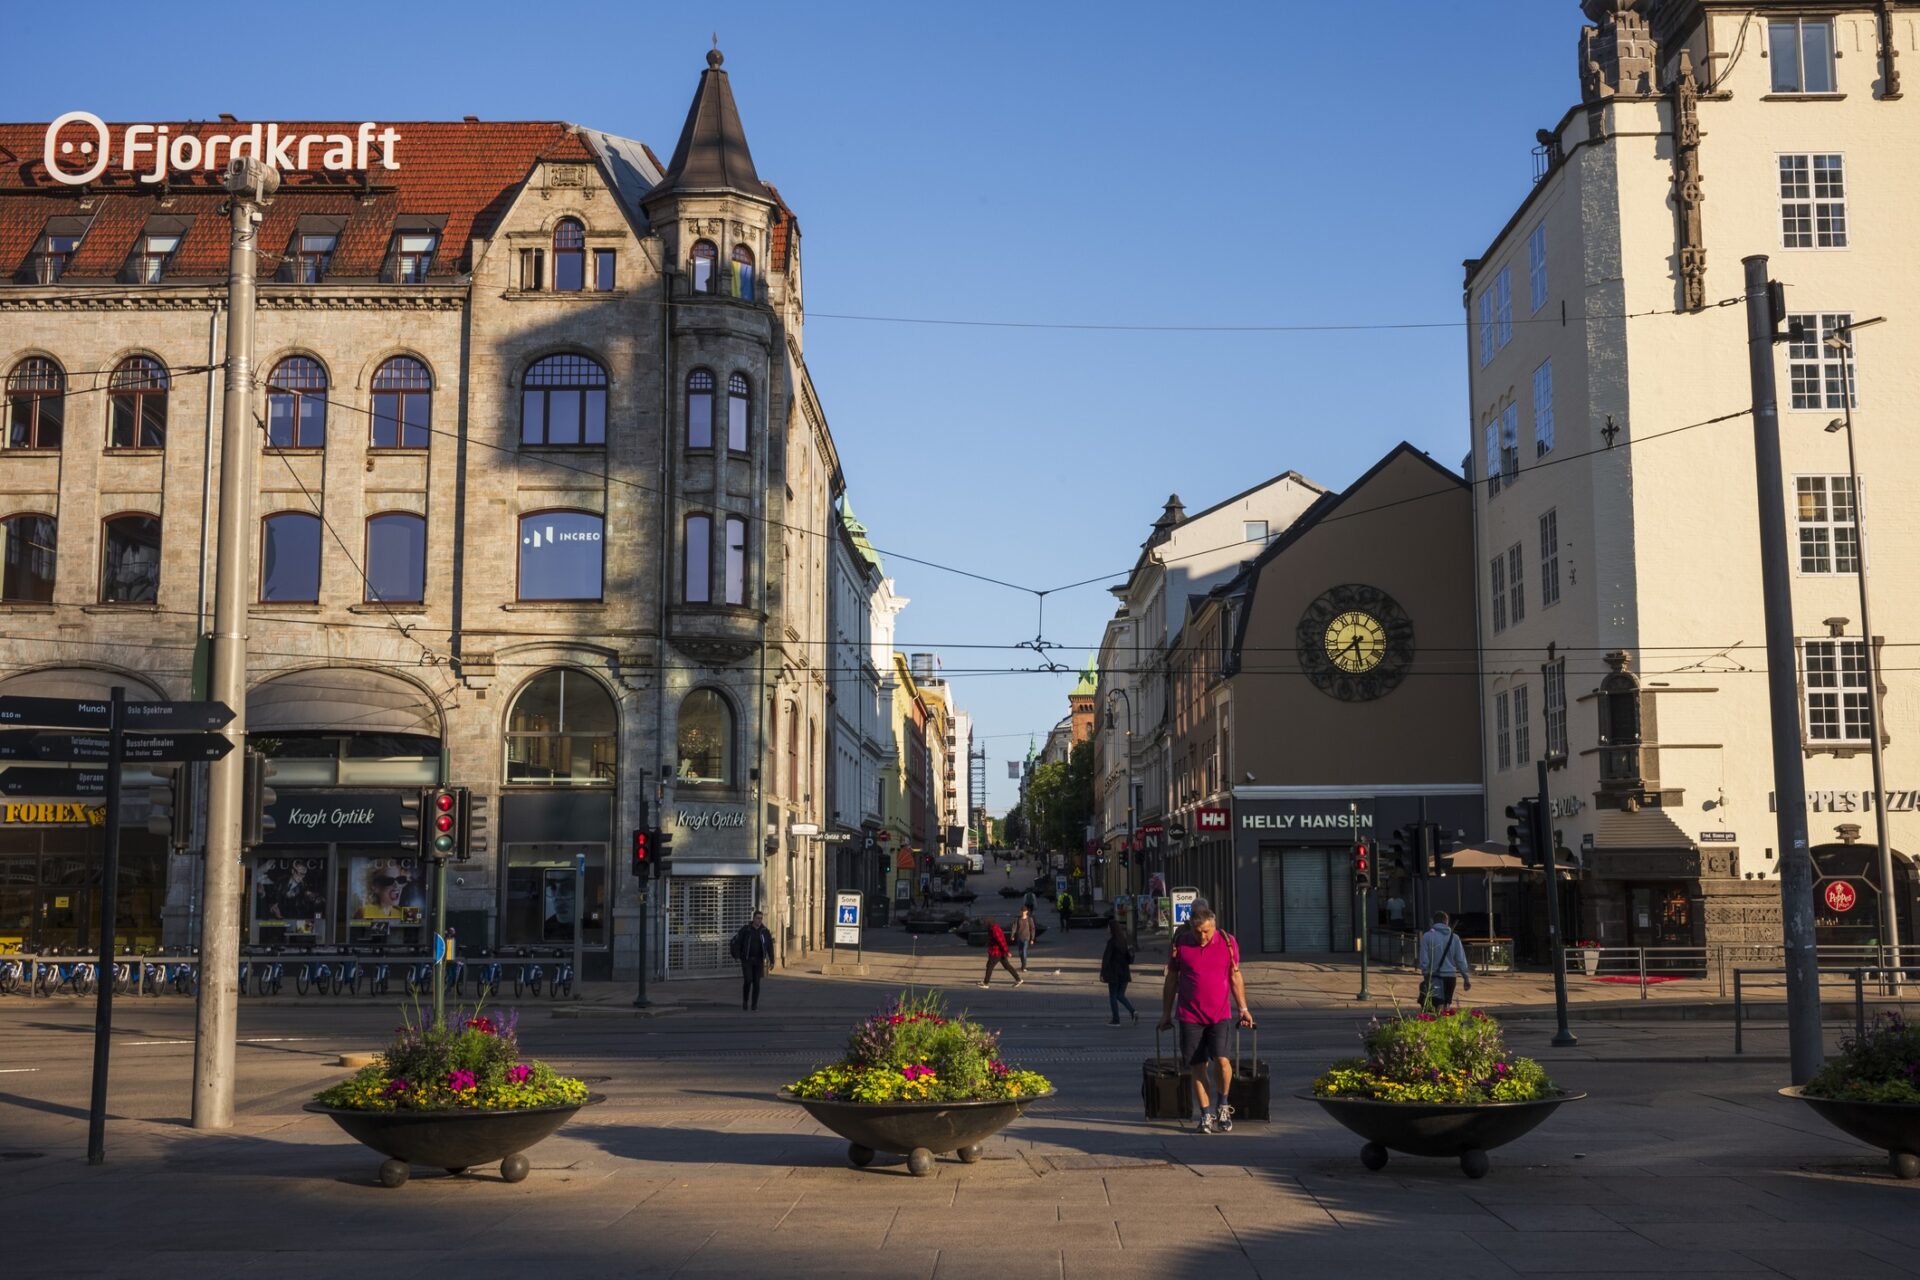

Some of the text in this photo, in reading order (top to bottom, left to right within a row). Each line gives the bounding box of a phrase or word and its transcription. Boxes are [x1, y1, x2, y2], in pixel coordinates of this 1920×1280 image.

[122, 122, 402, 184] Fjordkraft
[559, 532, 600, 542] INCREO
[78, 704, 106, 713] Munch
[128, 706, 172, 716] Oslo Spektrum
[126, 737, 174, 748] Bussterminalen
[80, 772, 104, 782] Operaen
[1769, 790, 1920, 812] PPES PZZ
[5, 803, 87, 823] FOREX
[288, 808, 375, 828] Krogh Optikk
[676, 810, 747, 830] Krogh Optikk
[1202, 812, 1225, 826] HH
[1242, 814, 1373, 828] HELLY HANSEN
[366, 858, 418, 869] UCCI
